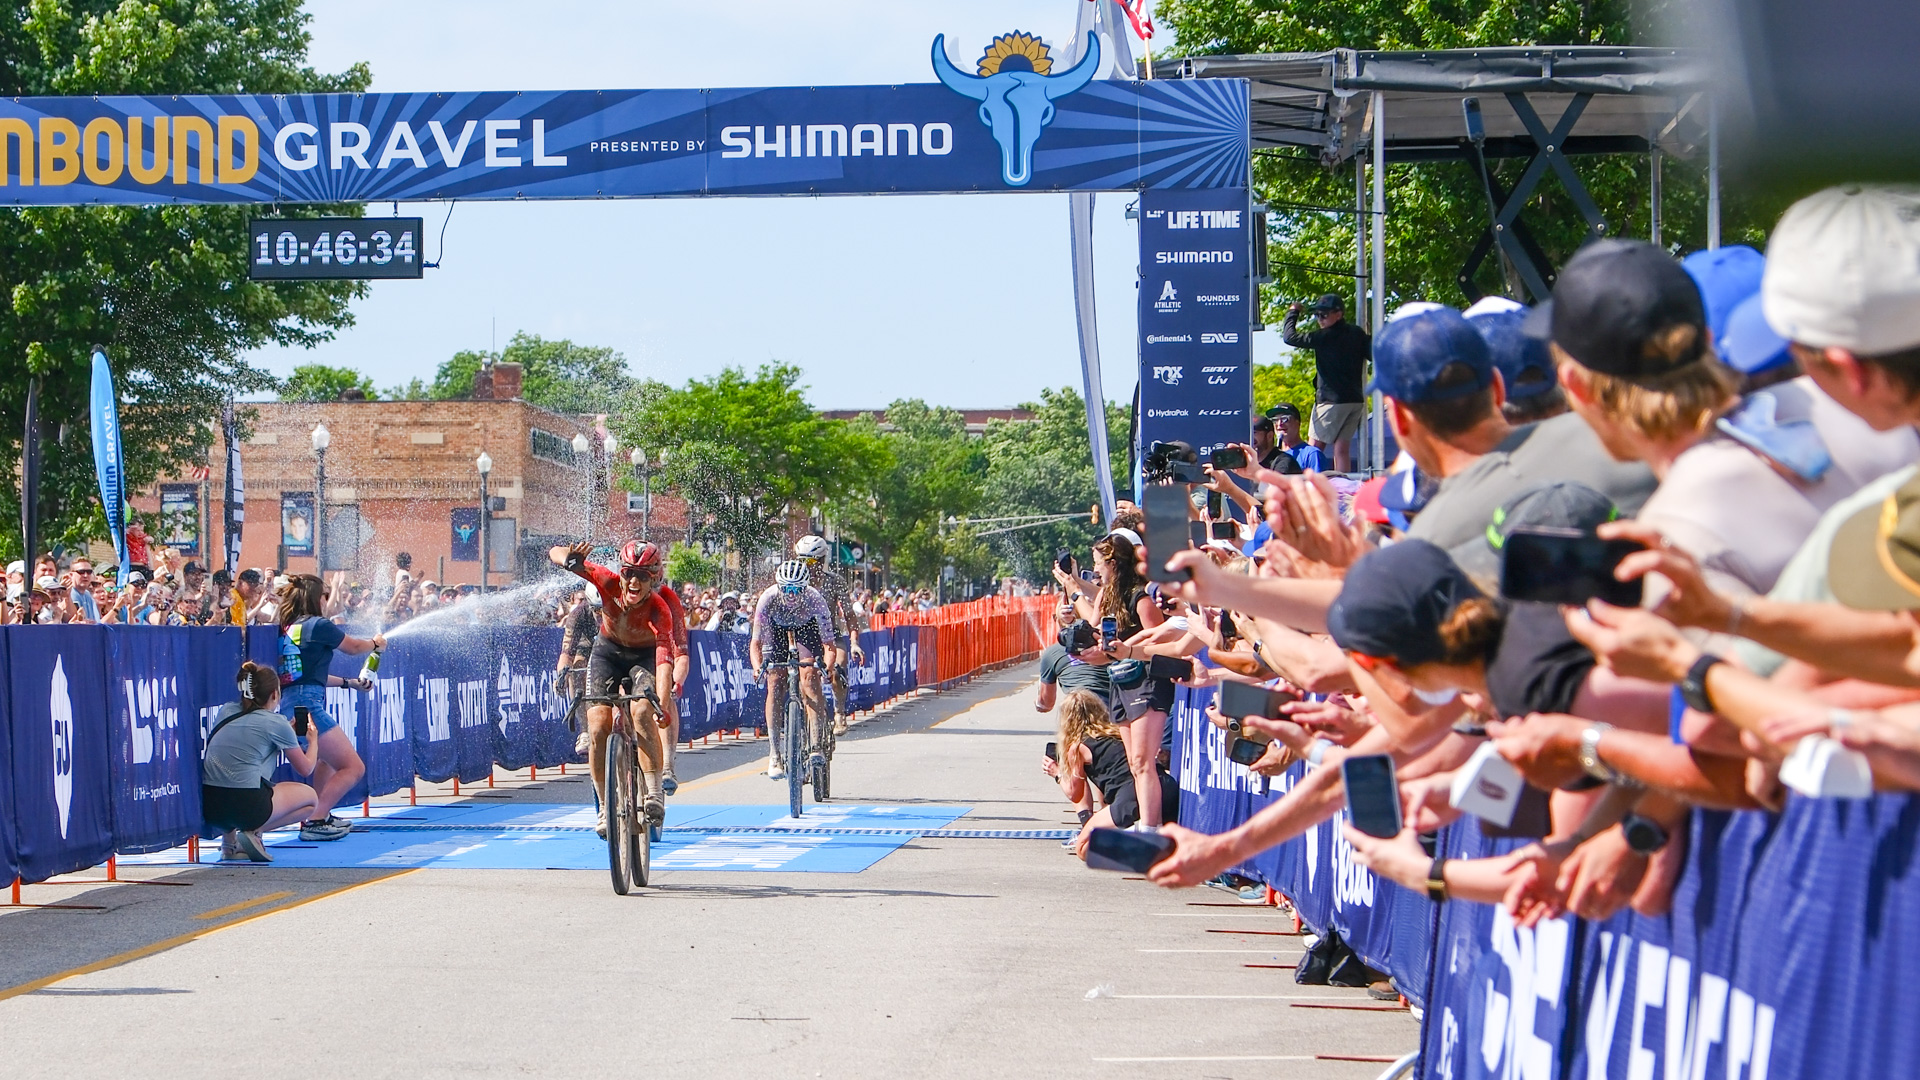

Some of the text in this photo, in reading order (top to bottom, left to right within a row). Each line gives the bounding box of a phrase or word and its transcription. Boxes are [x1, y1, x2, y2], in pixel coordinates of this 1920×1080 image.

[273, 118, 568, 170] GRAVEL
[590, 140, 705, 152] PRESENTED BY
[721, 121, 953, 159] SHIMANO
[1167, 210, 1240, 229] LIFE TIME
[255, 230, 416, 266] 10:46:34
[1155, 251, 1234, 263] SHIMANO
[1154, 301, 1182, 309] ATHLETIC
[1146, 334, 1187, 345] Continental
[1153, 366, 1183, 386] FOX
[1207, 375, 1228, 385] Liv
[1155, 409, 1189, 418] HydraPak
[104, 400, 116, 463] GRAVEL
